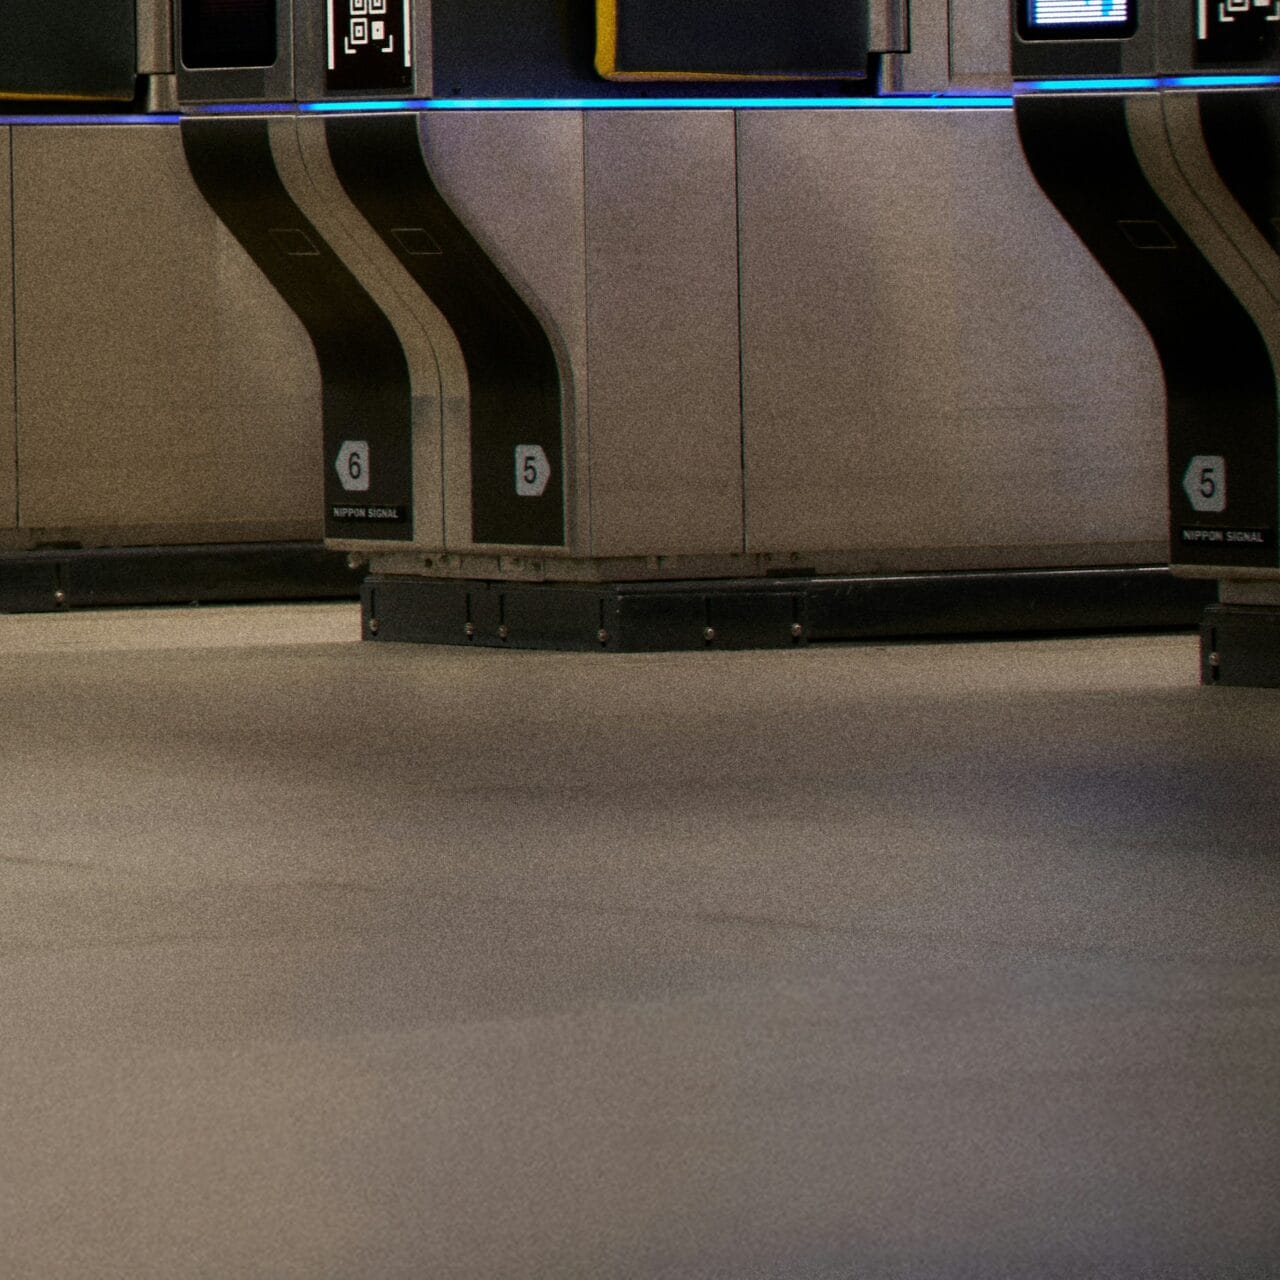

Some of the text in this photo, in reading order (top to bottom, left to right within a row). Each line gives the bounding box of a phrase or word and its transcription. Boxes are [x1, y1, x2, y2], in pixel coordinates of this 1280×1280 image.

[347, 451, 361, 480] 6
[523, 456, 537, 485] 5
[1200, 467, 1216, 499] 5
[332, 507, 399, 519] NIPPON SIGNAL
